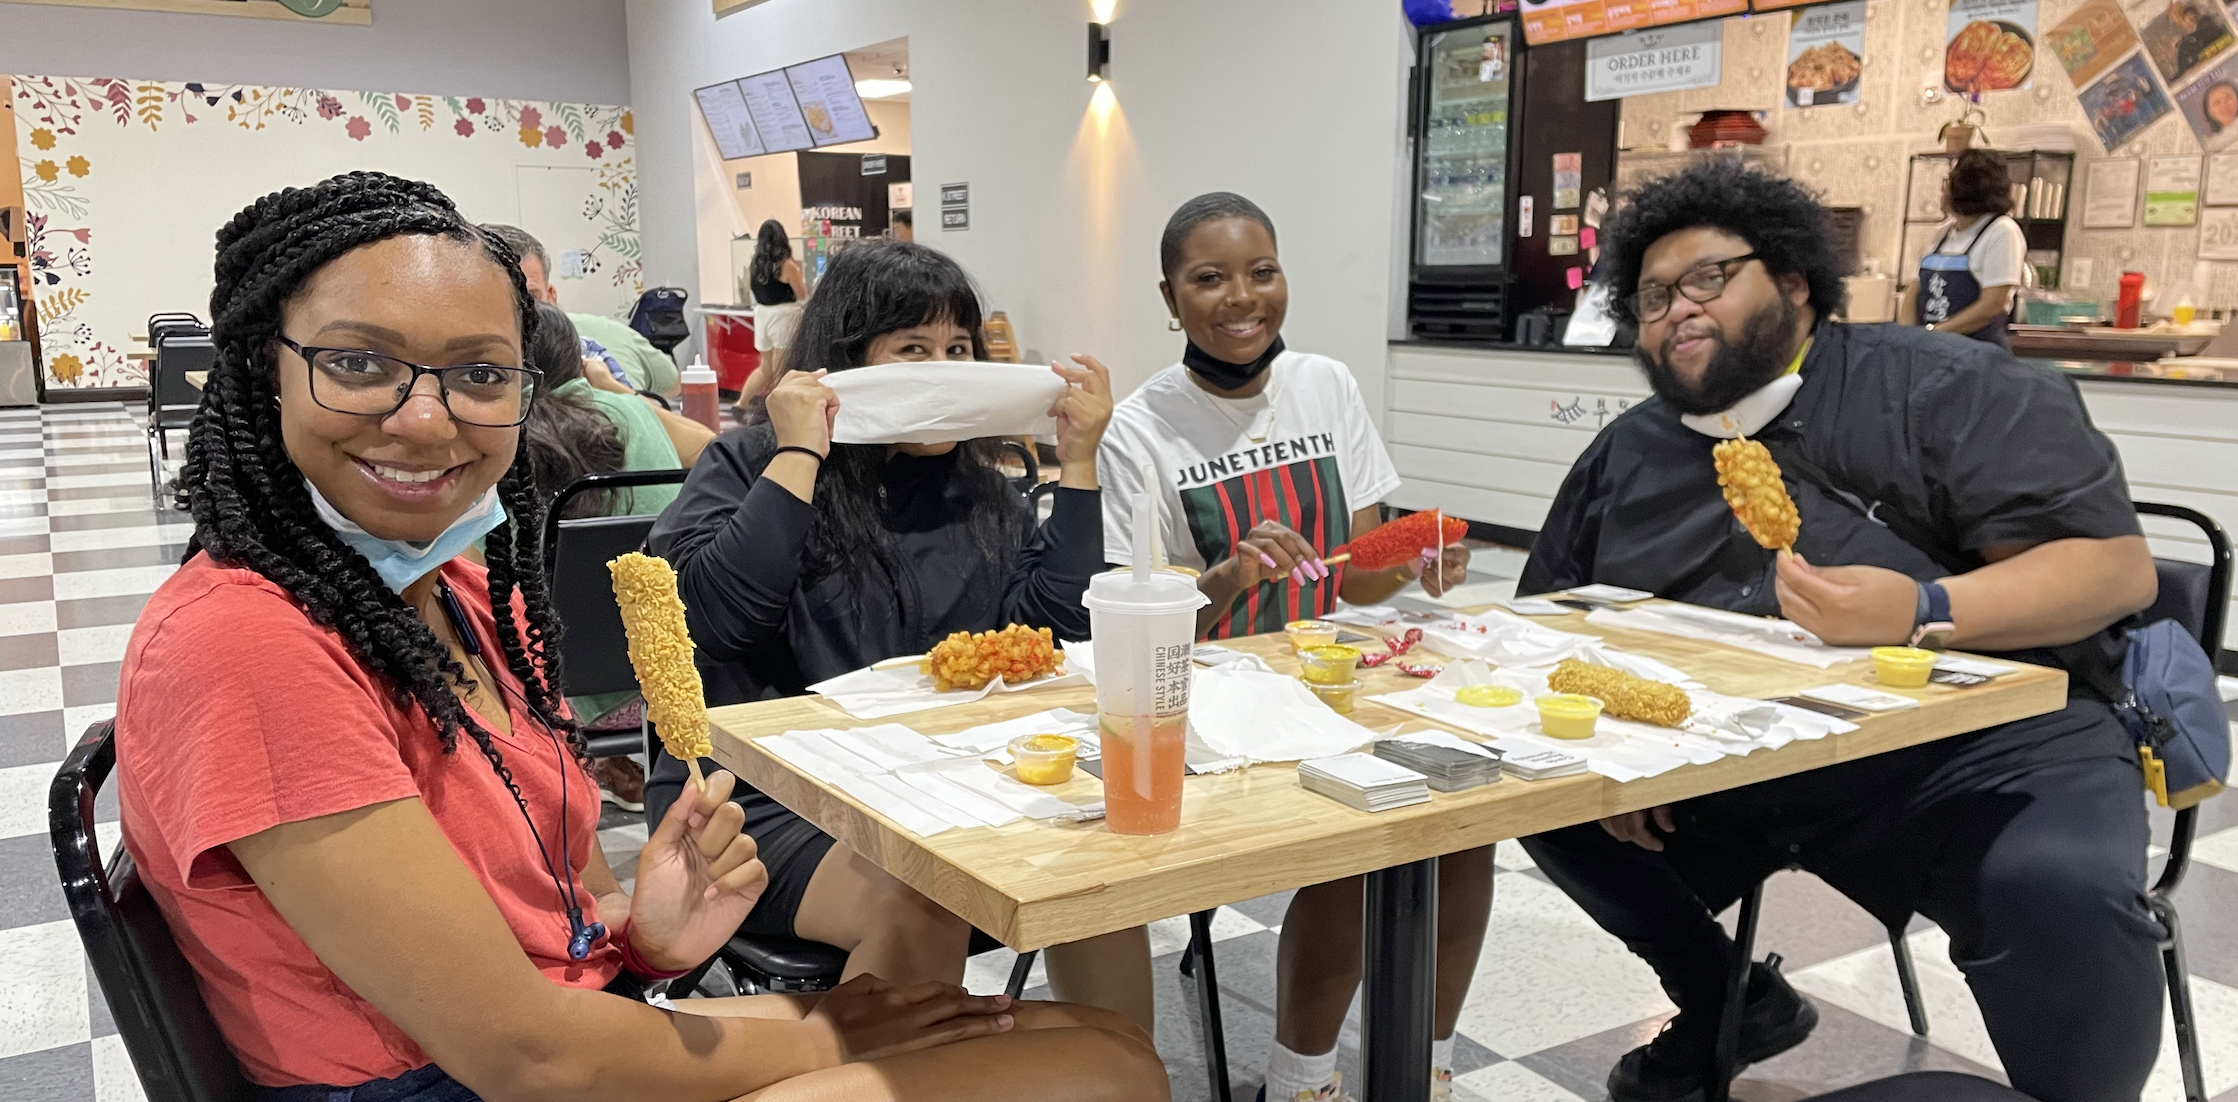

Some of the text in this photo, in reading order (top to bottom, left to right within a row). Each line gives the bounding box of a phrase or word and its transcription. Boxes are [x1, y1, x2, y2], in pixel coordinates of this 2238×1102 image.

[1608, 46, 1700, 71] ORDER HERE
[811, 206, 862, 220] KOREAN
[831, 225, 861, 238] REET
[1177, 432, 1335, 486] JUNETEENTH
[1155, 646, 1166, 711] CHINESE STYLE
